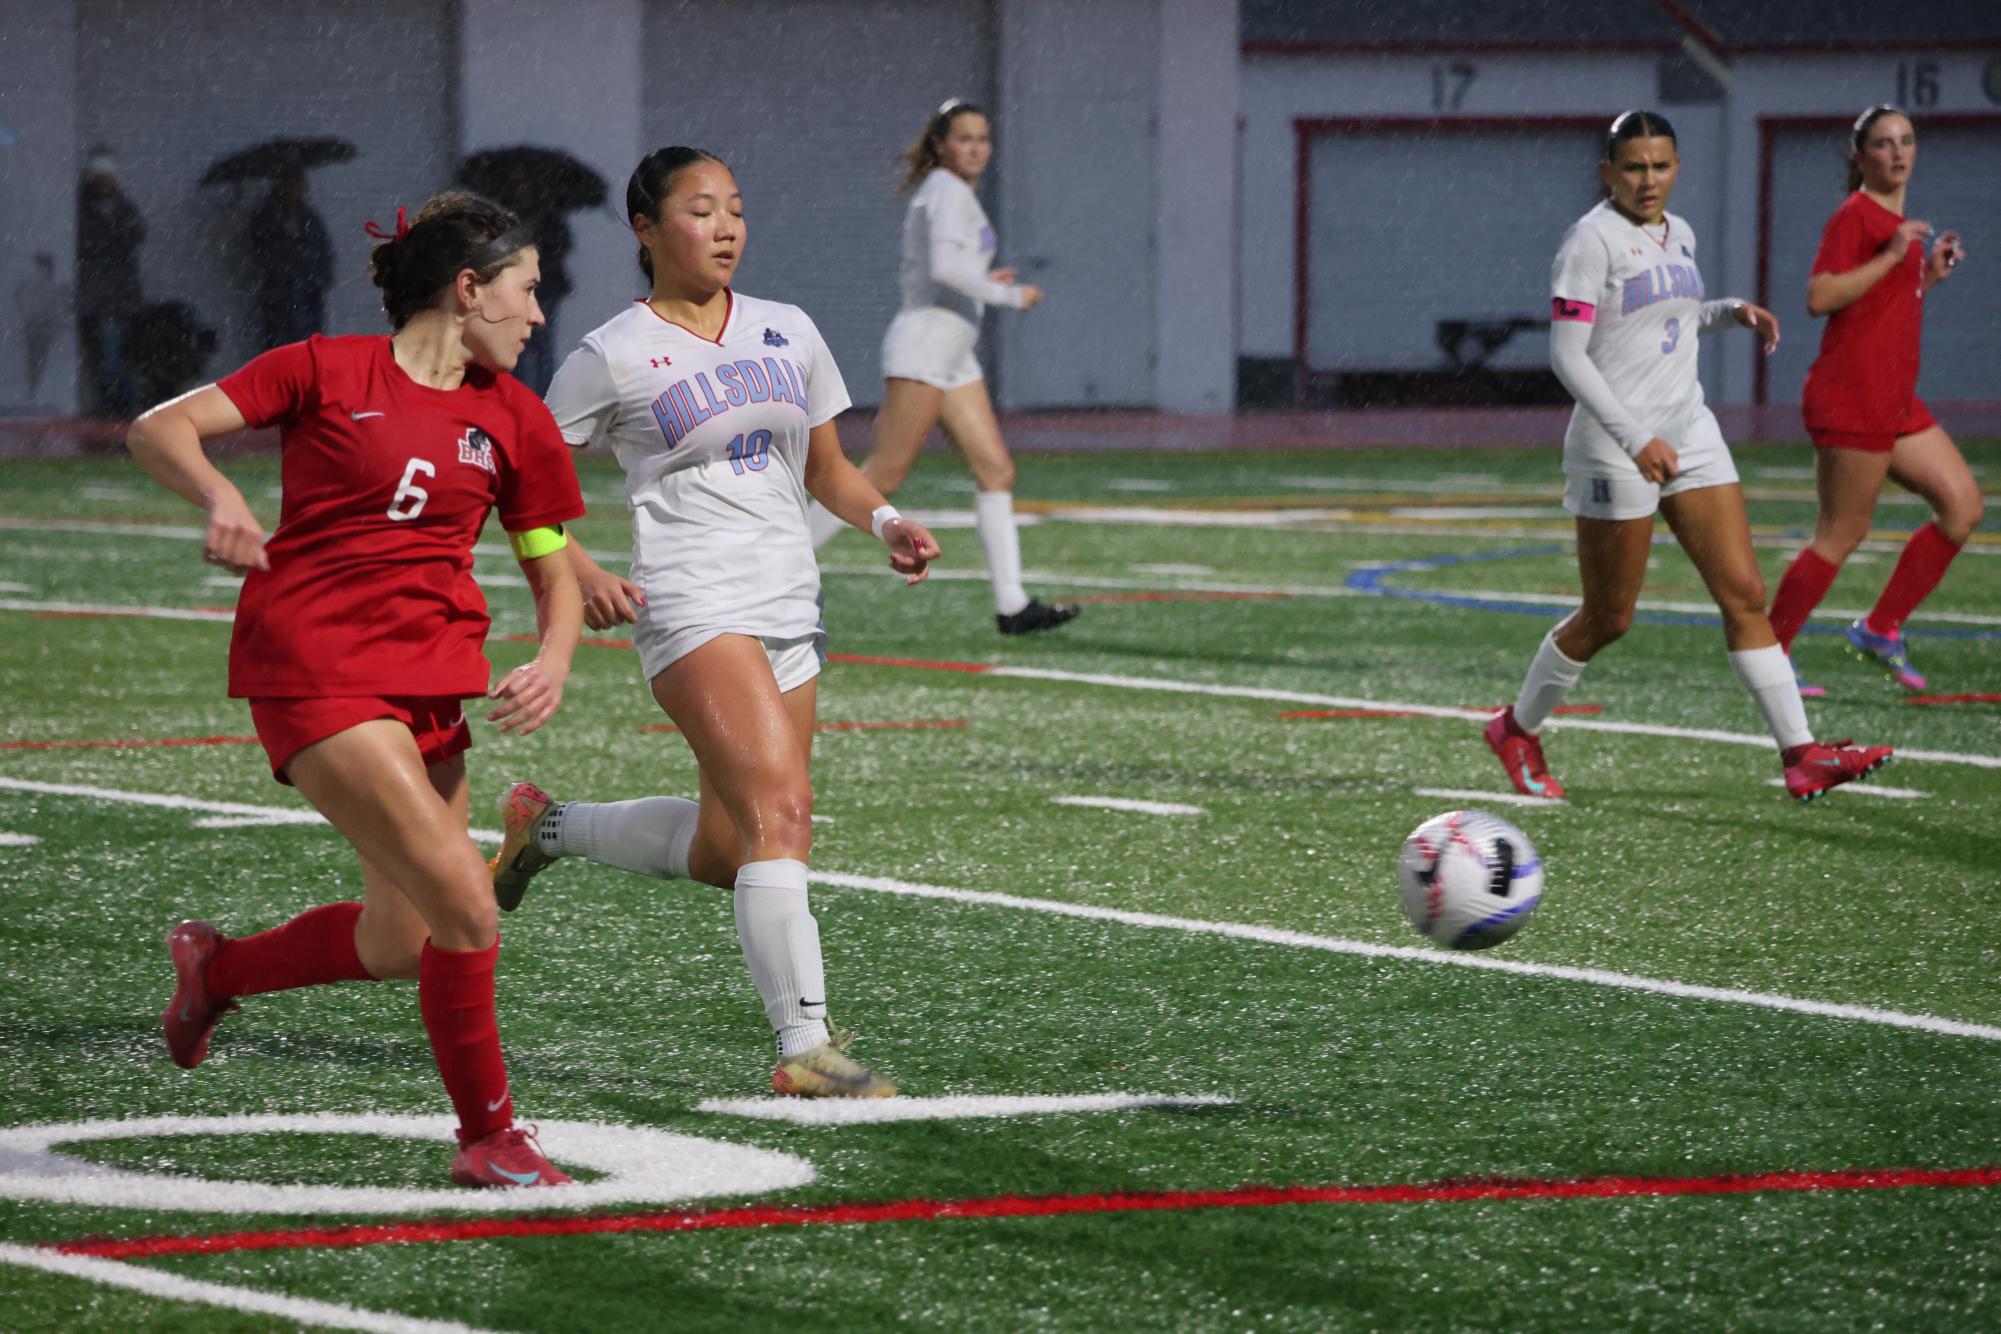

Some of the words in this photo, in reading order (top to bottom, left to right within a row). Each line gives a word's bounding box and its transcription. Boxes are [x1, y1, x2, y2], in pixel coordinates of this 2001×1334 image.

[1431, 62, 1478, 110] 17
[1896, 61, 1941, 109] 16
[1661, 317, 1680, 354] 3
[726, 428, 773, 476] 10
[386, 457, 436, 521] 6
